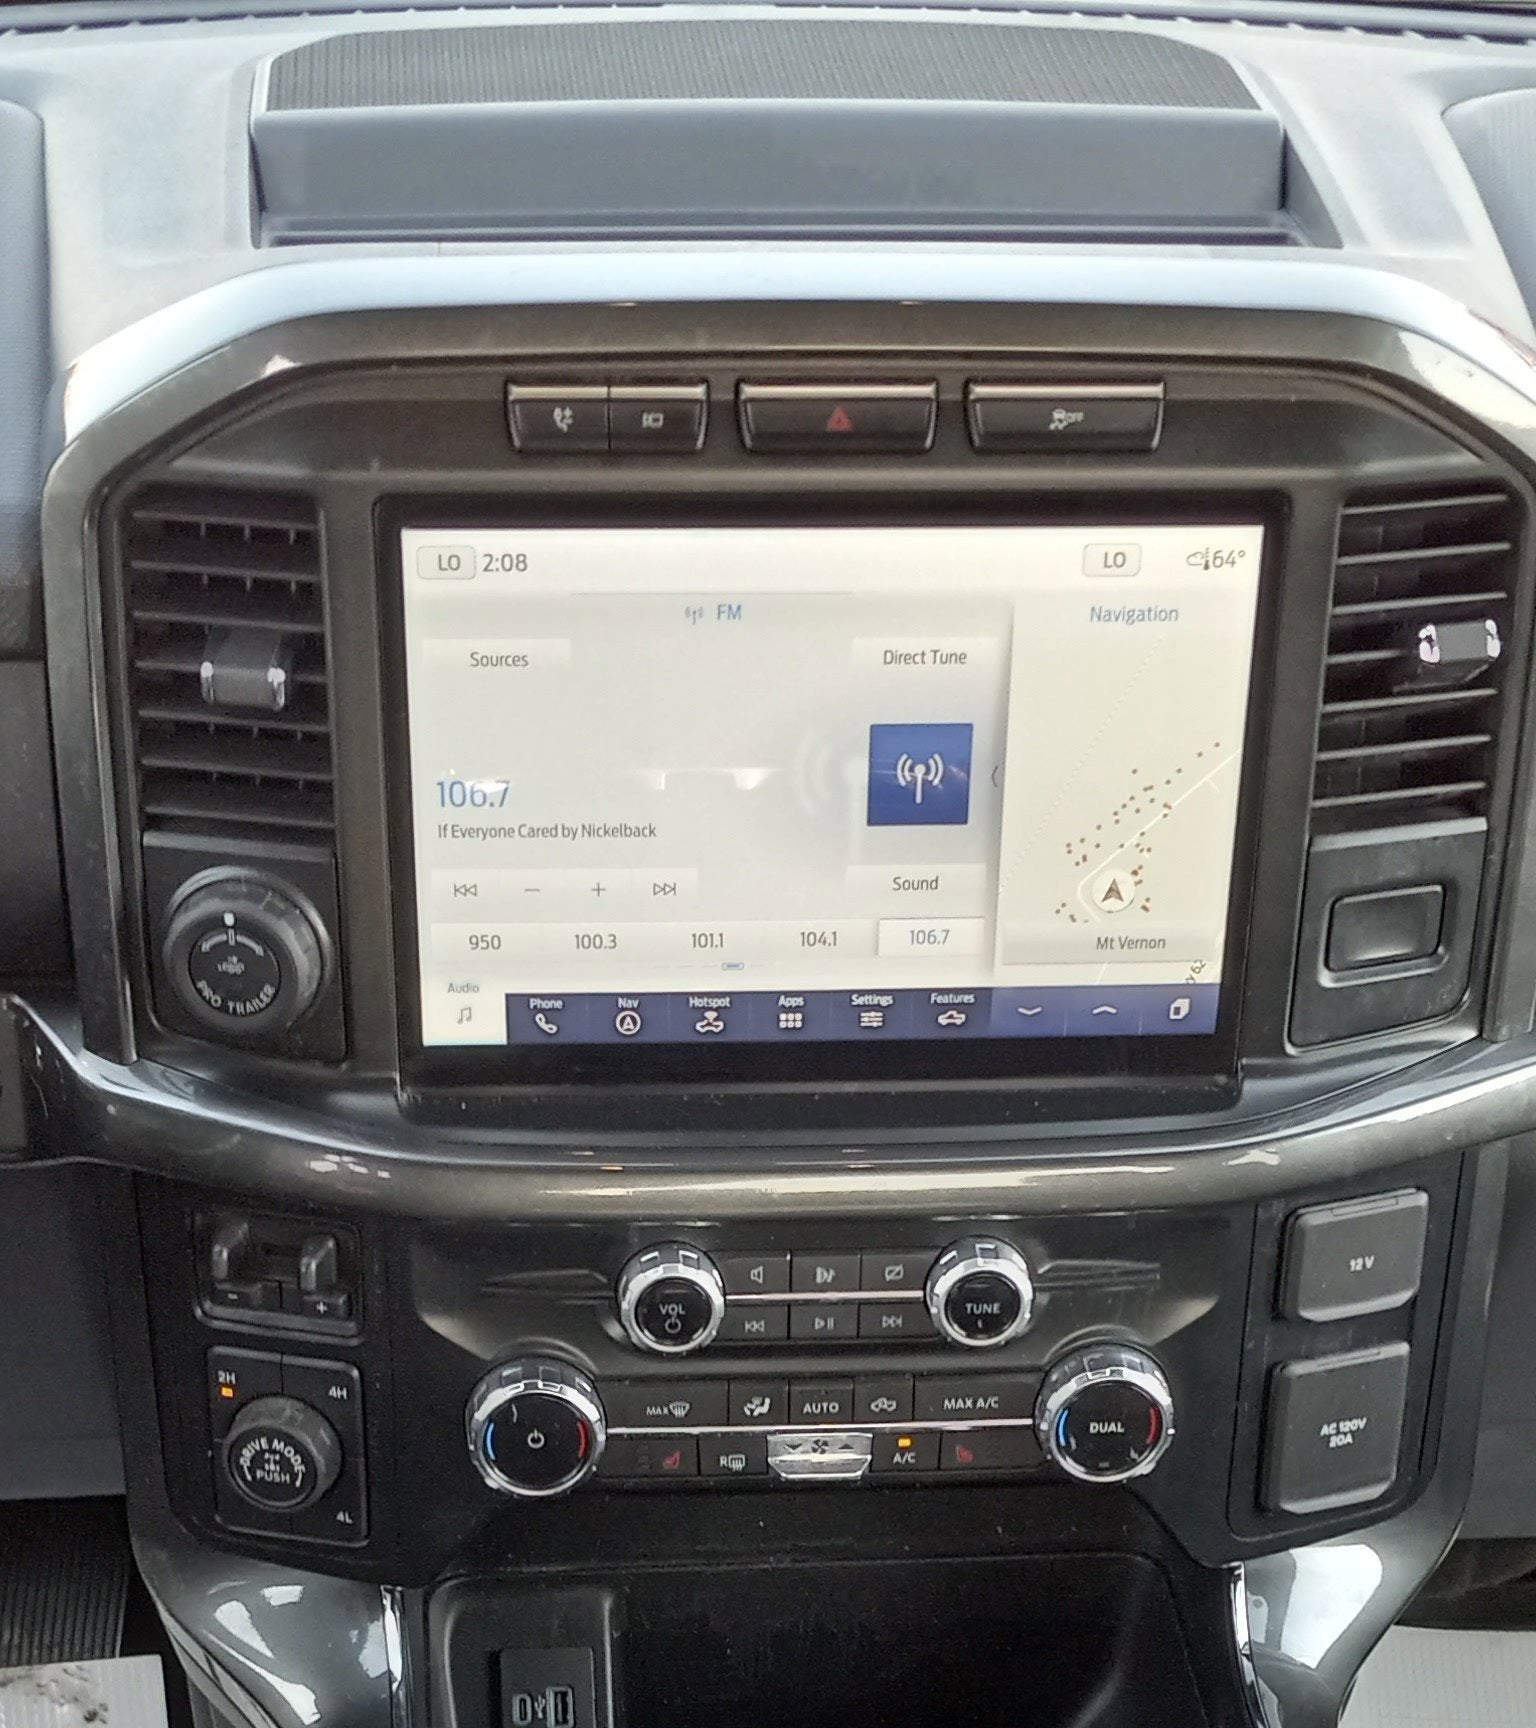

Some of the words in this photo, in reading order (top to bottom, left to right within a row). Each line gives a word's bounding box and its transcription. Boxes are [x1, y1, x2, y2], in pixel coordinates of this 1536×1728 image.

[437, 554, 462, 572] LO
[482, 553, 528, 572] 2:08
[1103, 552, 1126, 570] LO
[1212, 549, 1246, 570] 64°
[716, 604, 742, 621] FM
[1090, 606, 1180, 624] Navigation
[470, 651, 529, 669] Sources
[883, 649, 926, 666] Direct
[930, 649, 968, 666] Tune
[436, 780, 511, 808] 106.7
[438, 824, 448, 839] If
[450, 824, 516, 841] Everyone
[518, 824, 559, 839] Cared
[561, 824, 578, 841] by
[581, 823, 657, 838] Nickelback
[892, 876, 939, 892] Sound
[468, 934, 502, 951] 950
[574, 933, 618, 950] 100.3
[691, 932, 724, 948] 101.1
[800, 931, 838, 947] 104.1
[909, 929, 950, 945] 106.7
[1096, 936, 1114, 950] Mt
[1116, 936, 1166, 950] Vernon
[448, 982, 480, 994] Audio
[530, 997, 563, 1010] Phone
[618, 997, 639, 1009] Nav
[689, 996, 730, 1010] Hotspot
[778, 996, 804, 1009] Apps
[850, 993, 894, 1007] Settings
[930, 992, 976, 1004] Features
[658, 1303, 686, 1316] VOL
[964, 1302, 1001, 1315] TUNE
[218, 1370, 236, 1385] 2H
[328, 1385, 348, 1400] 4H
[646, 1405, 669, 1416] MAX
[802, 1402, 839, 1414] AUTO
[944, 1398, 972, 1410] MAX
[976, 1396, 999, 1410] A/C
[1089, 1421, 1125, 1434] DUAL
[1320, 1423, 1338, 1437] AC
[1338, 1417, 1368, 1434] 120V
[1329, 1433, 1354, 1448] 20A
[240, 1436, 270, 1467] DRIVE
[272, 1438, 306, 1473] MODE
[893, 1452, 916, 1464] A/C
[256, 1468, 290, 1484] PUSH
[336, 1510, 353, 1524] 4L
